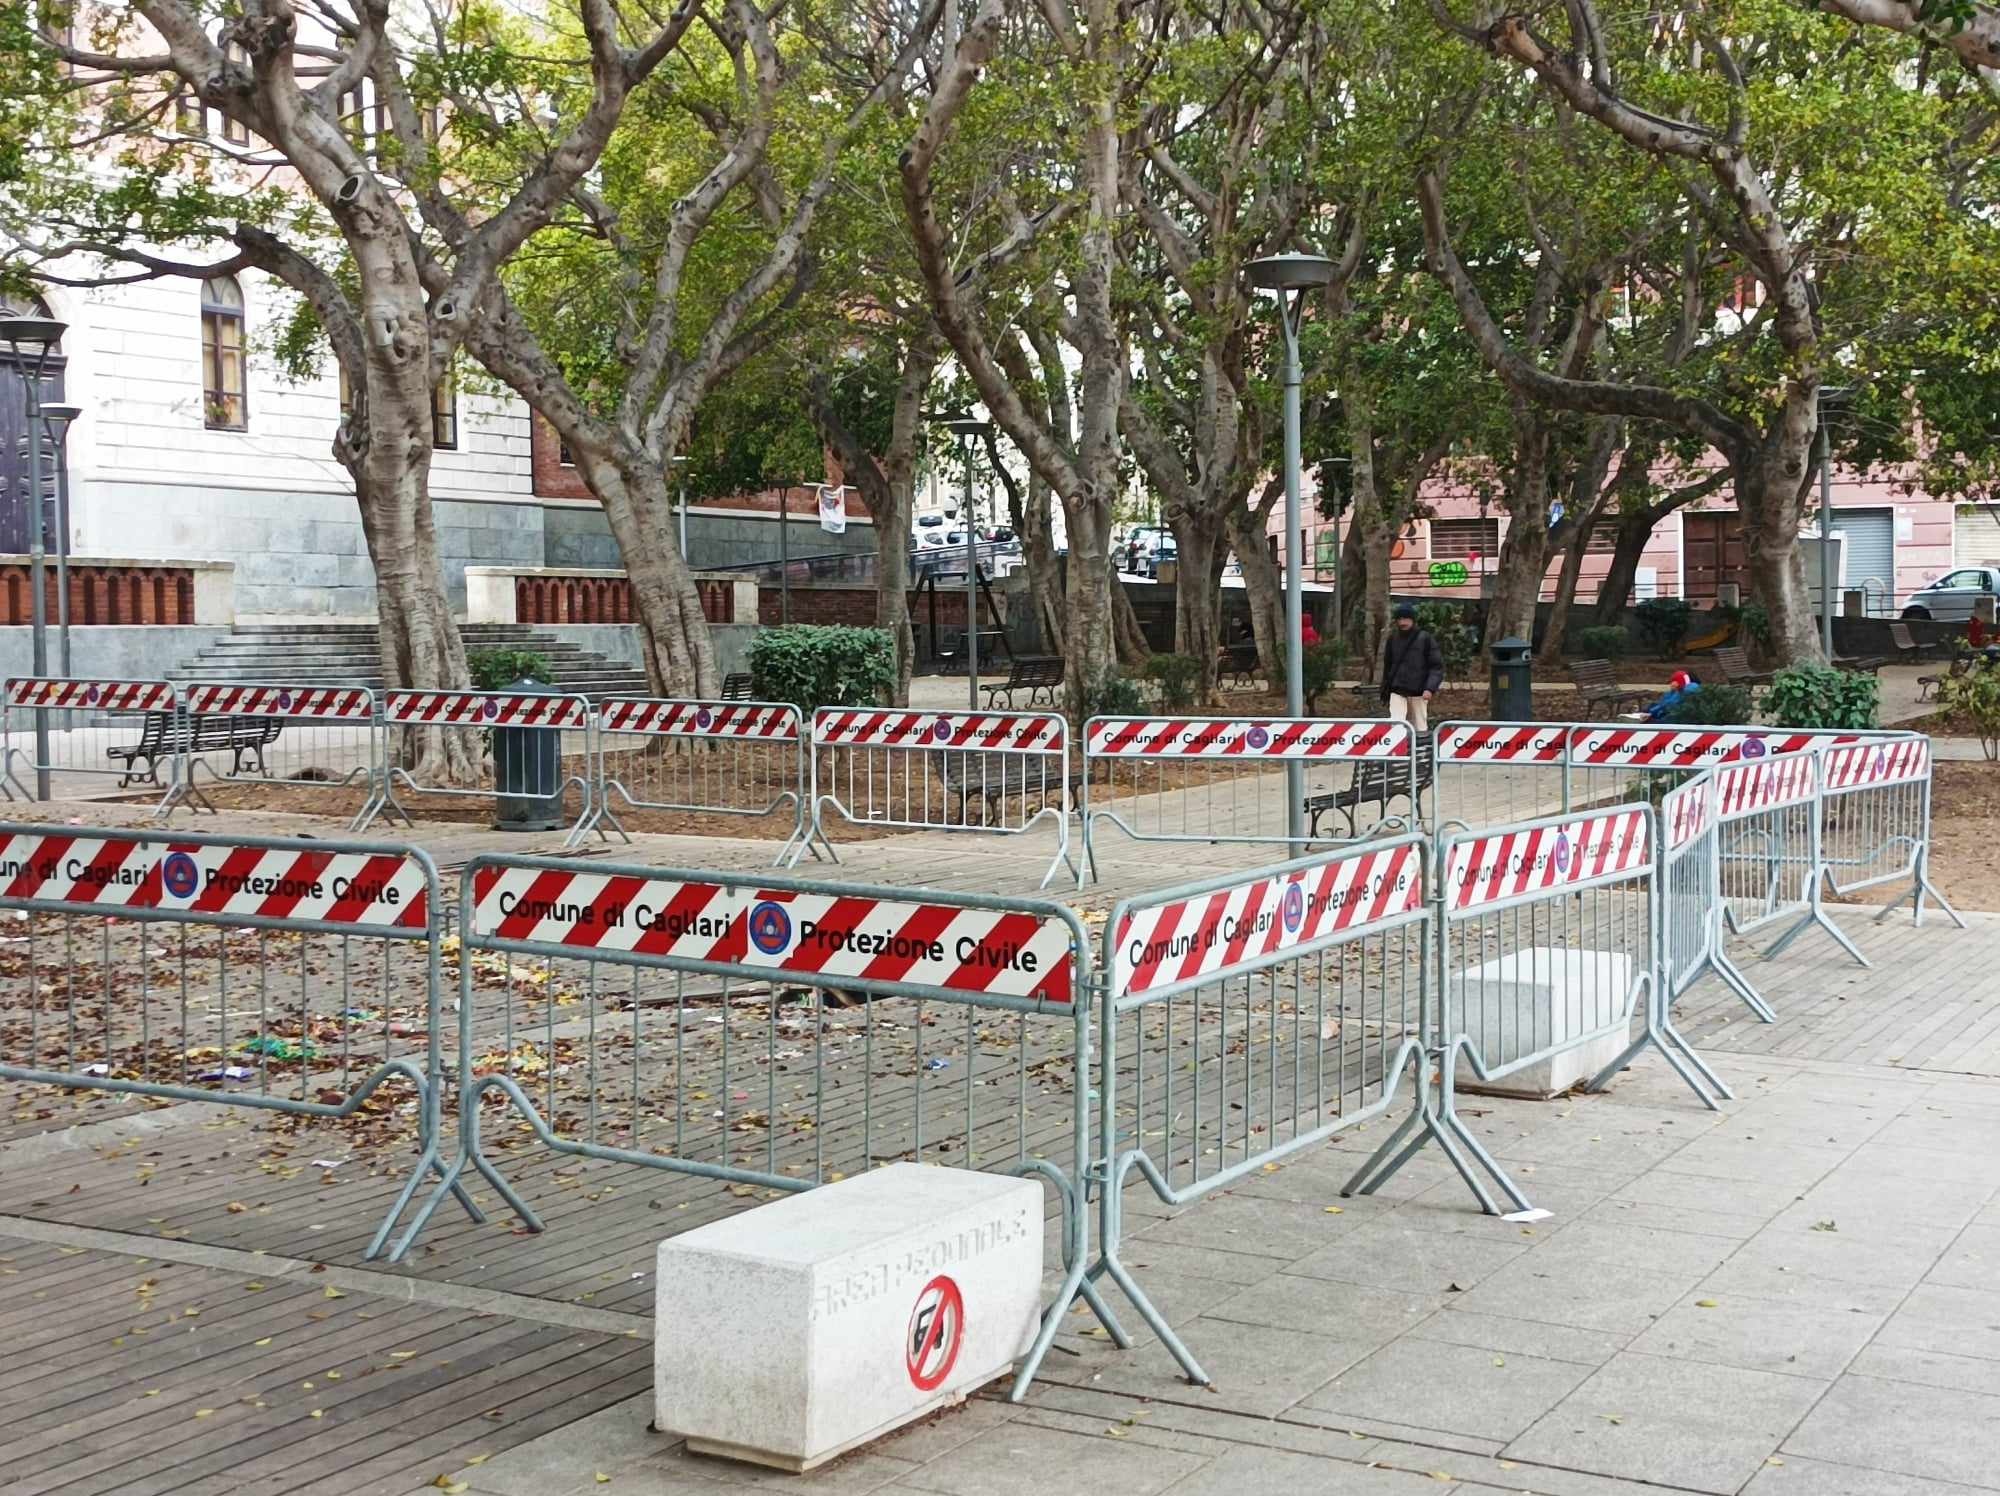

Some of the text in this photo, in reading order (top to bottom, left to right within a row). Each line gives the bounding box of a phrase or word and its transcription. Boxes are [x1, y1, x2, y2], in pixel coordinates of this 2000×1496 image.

[826, 722, 866, 735] Comune
[883, 723, 928, 740] Cagliari
[954, 726, 1013, 740] Protezione
[1016, 728, 1048, 741] Civile
[1103, 730, 1392, 749] Comune di Cagliari Protezione Civile
[1453, 736, 1510, 751] Comune
[1515, 734, 1529, 751] di
[1588, 739, 1732, 759] Comune di Cagliari
[37, 857, 58, 880] di
[67, 859, 147, 887] Cagliari
[205, 868, 323, 899] Protezione
[332, 876, 399, 905] Civile
[1129, 873, 1406, 967] Comune di Cagliari Protezione Civile
[499, 891, 1038, 973] Comune di Cagliari Protezione Civile
